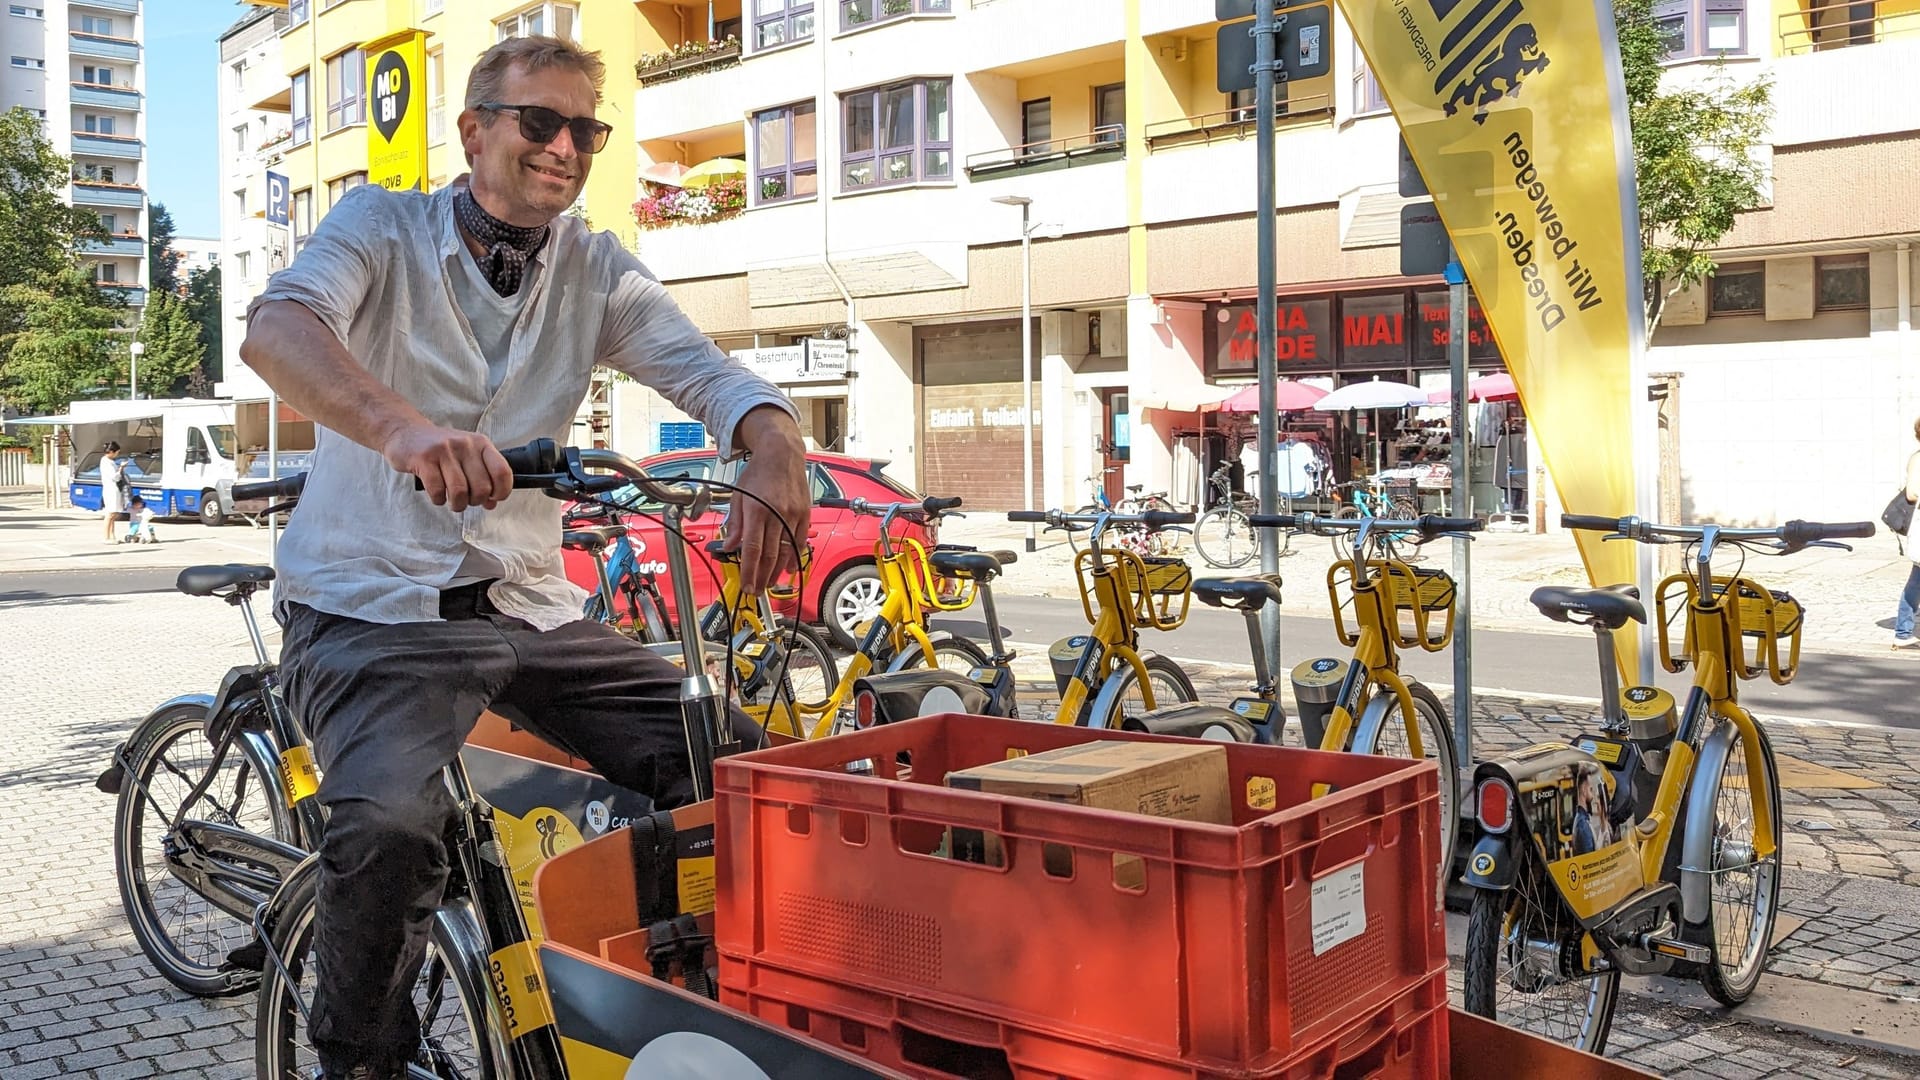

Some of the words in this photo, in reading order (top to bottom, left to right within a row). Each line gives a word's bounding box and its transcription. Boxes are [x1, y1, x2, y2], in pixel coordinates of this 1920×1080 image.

[377, 67, 401, 99] MO
[382, 94, 397, 122] BI
[385, 174, 402, 189] DVB
[269, 177, 283, 216] P
[1236, 305, 1308, 334] AIA
[1344, 312, 1404, 348] MAI
[1229, 334, 1317, 363] MDE
[1432, 327, 1482, 347] Sce,
[930, 407, 975, 428] Einfahrt
[982, 405, 1042, 427] freihaltn
[639, 559, 668, 575] uto
[1090, 647, 1102, 669] DVB
[591, 807, 605, 818] MO
[594, 816, 603, 826] BI
